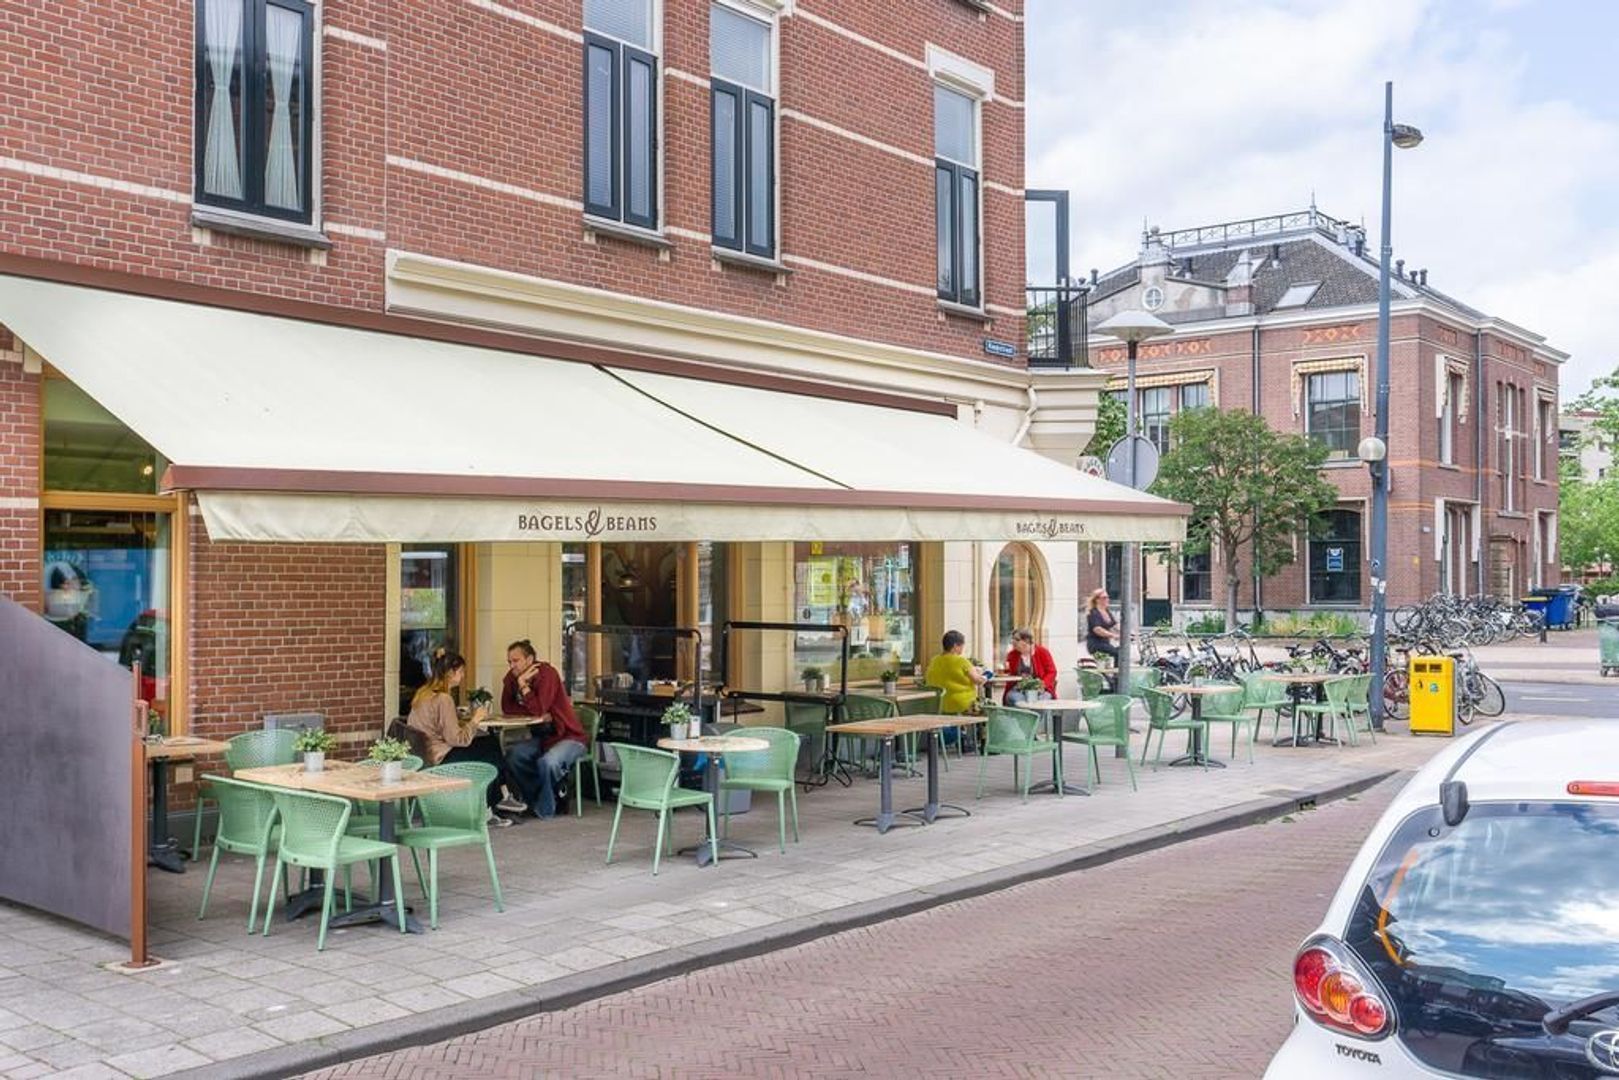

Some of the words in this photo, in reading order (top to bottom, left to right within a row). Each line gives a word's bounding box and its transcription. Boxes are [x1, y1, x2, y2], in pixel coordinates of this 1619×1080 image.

[518, 514, 583, 531] BAGELS
[606, 516, 657, 531] BEANS
[1335, 1043, 1382, 1066] TOYOTA
